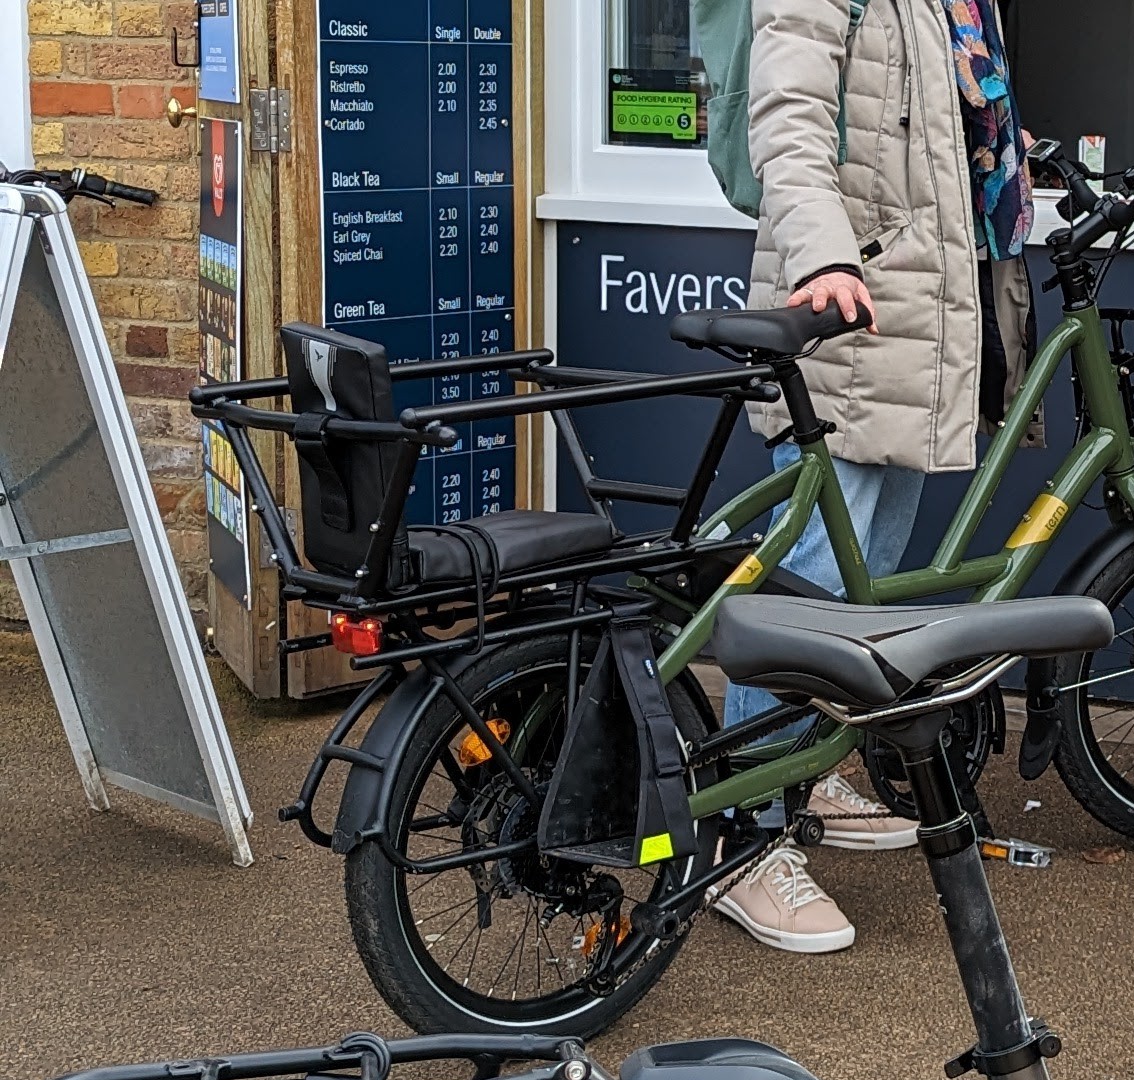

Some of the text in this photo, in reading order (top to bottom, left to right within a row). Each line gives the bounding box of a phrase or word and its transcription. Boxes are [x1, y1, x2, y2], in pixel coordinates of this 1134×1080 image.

[329, 20, 368, 37] Classic
[435, 26, 461, 42] Single
[474, 28, 501, 40] Double
[330, 61, 368, 76] Espresso
[438, 63, 456, 75] 2.00
[479, 64, 497, 76] 2.30
[330, 80, 365, 93] Ristretto
[438, 82, 457, 94] 2.00
[479, 82, 497, 94] 2.30
[330, 100, 374, 112] Macchiato
[438, 100, 457, 112] 2.10
[479, 100, 497, 112] 2.35
[668, 96, 691, 104] RATING
[330, 118, 365, 130] Cortado
[479, 117, 497, 130] 2.45
[680, 115, 688, 128] 5
[332, 171, 380, 187] Black Tea
[436, 172, 459, 185] Small
[475, 171, 504, 186] Regular
[333, 210, 403, 227] English Breakfast
[439, 208, 457, 221] 2.10
[480, 206, 498, 219] 2.30
[439, 226, 458, 239] 2.20
[480, 224, 498, 237] 2.40
[333, 231, 371, 245] Earl Grey
[440, 244, 458, 257] 2.20
[480, 241, 498, 254] 2.40
[333, 247, 383, 265] Spiced Chai
[438, 297, 460, 310] Small
[476, 294, 505, 310] Regular
[334, 301, 385, 319] Green Tea
[441, 333, 459, 346] 2.20
[482, 329, 499, 343] 2.40
[442, 386, 459, 399] 3.50
[482, 381, 499, 395] 3.70
[478, 434, 507, 449] Regular
[442, 474, 460, 488] 2.20
[483, 468, 500, 482] 2.40
[483, 485, 500, 499] 2.40
[443, 492, 460, 506] 2.20
[443, 509, 460, 523] 2.20
[483, 503, 500, 516] 2.40
[1045, 505, 1065, 531] tern
